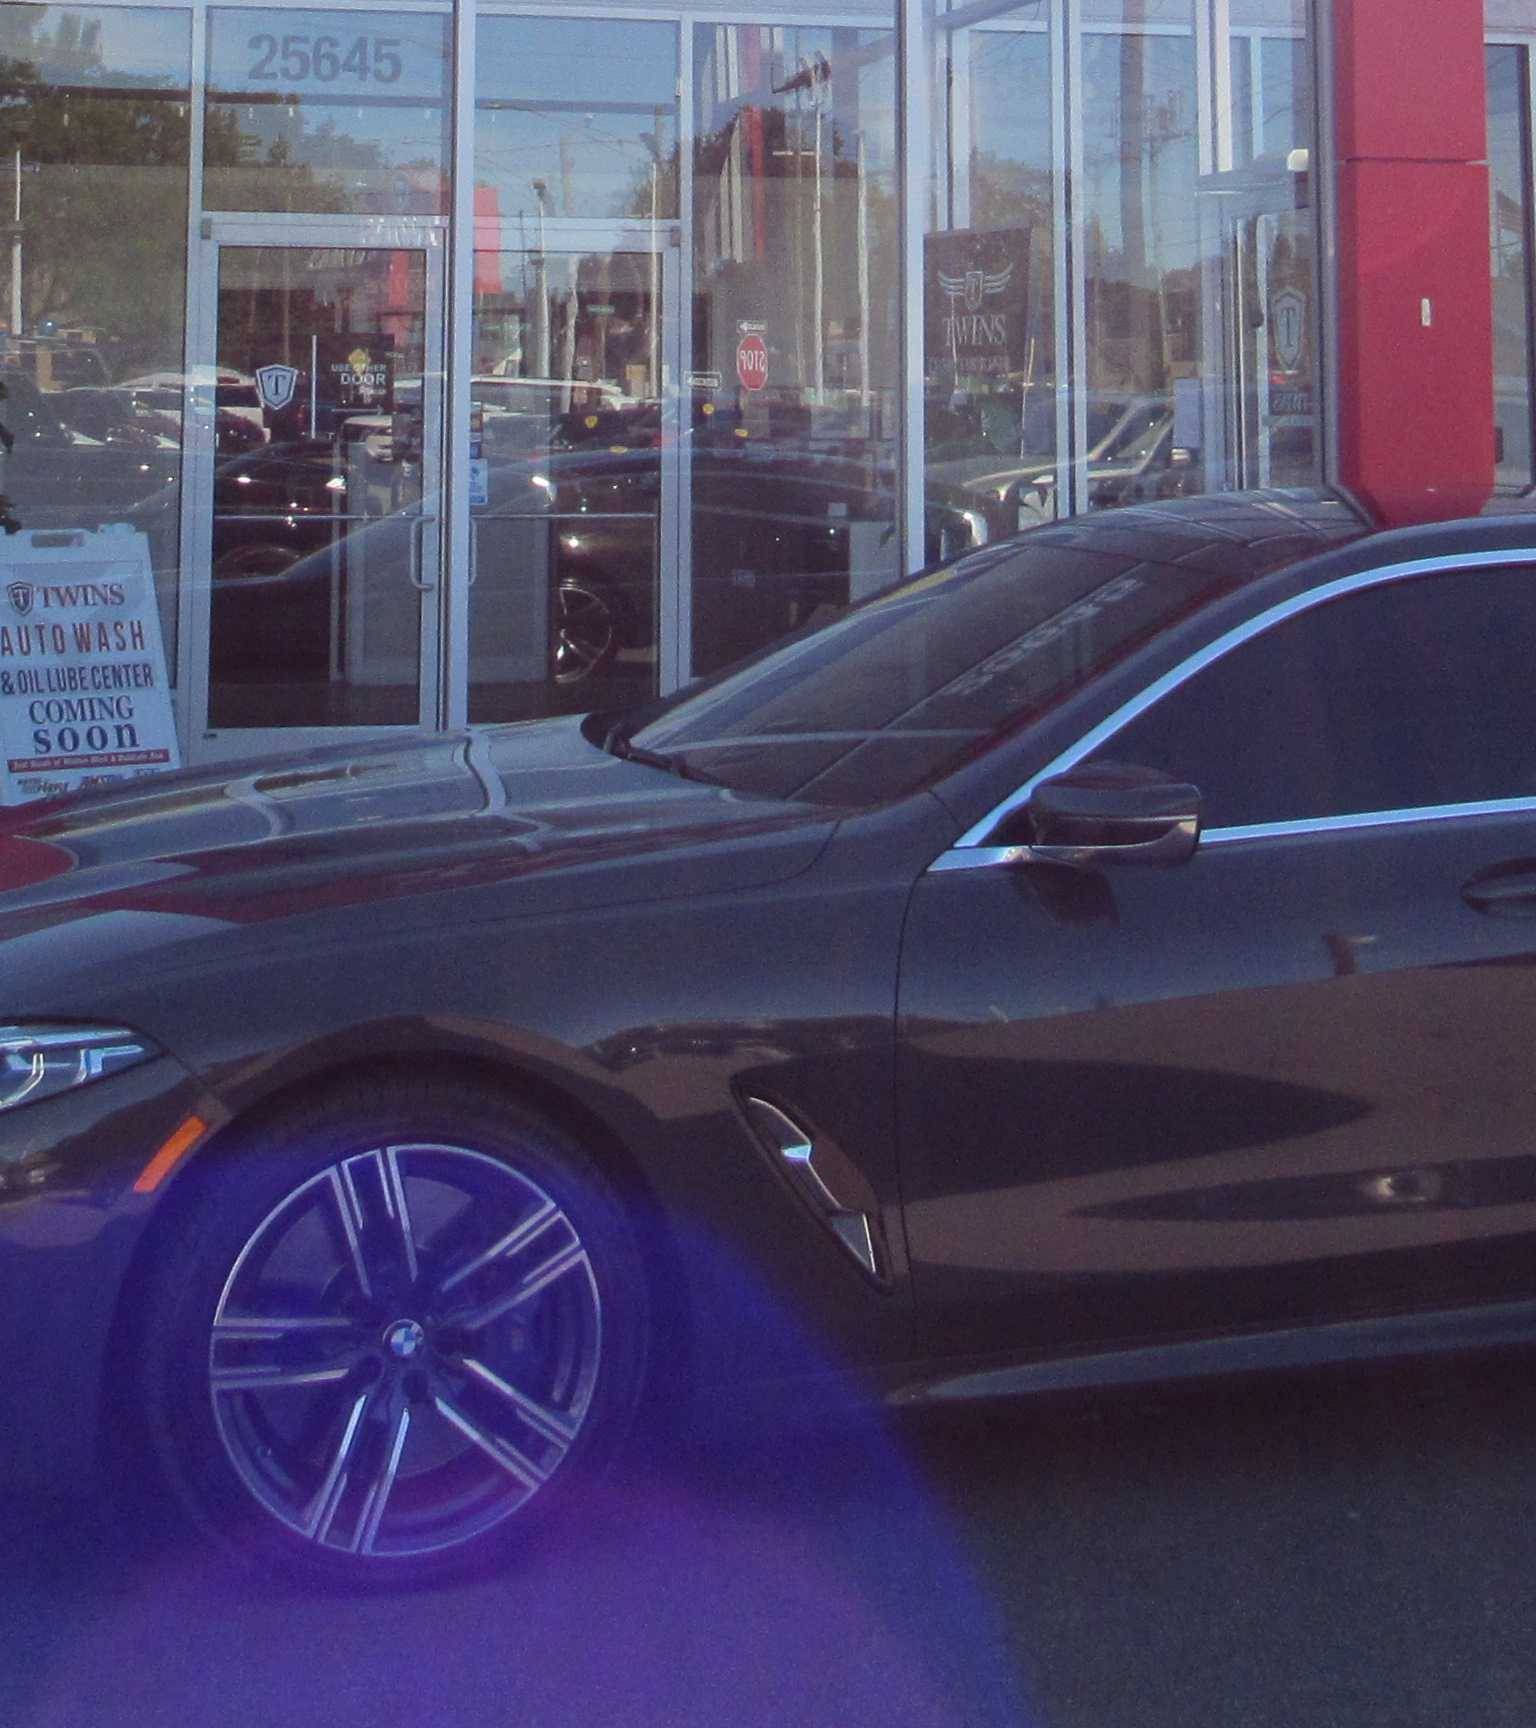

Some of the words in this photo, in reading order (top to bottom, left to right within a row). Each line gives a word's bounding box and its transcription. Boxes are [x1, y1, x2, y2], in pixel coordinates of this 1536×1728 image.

[248, 33, 403, 83] 25645
[340, 373, 387, 385] DOOR
[36, 583, 126, 609] TWINS
[0, 623, 66, 657] AUTO
[72, 620, 146, 654] WASH
[1, 670, 15, 695] &
[17, 669, 45, 694] OIL
[47, 666, 89, 693] LUBE
[90, 663, 154, 690] CENTER
[29, 695, 135, 725] COMING
